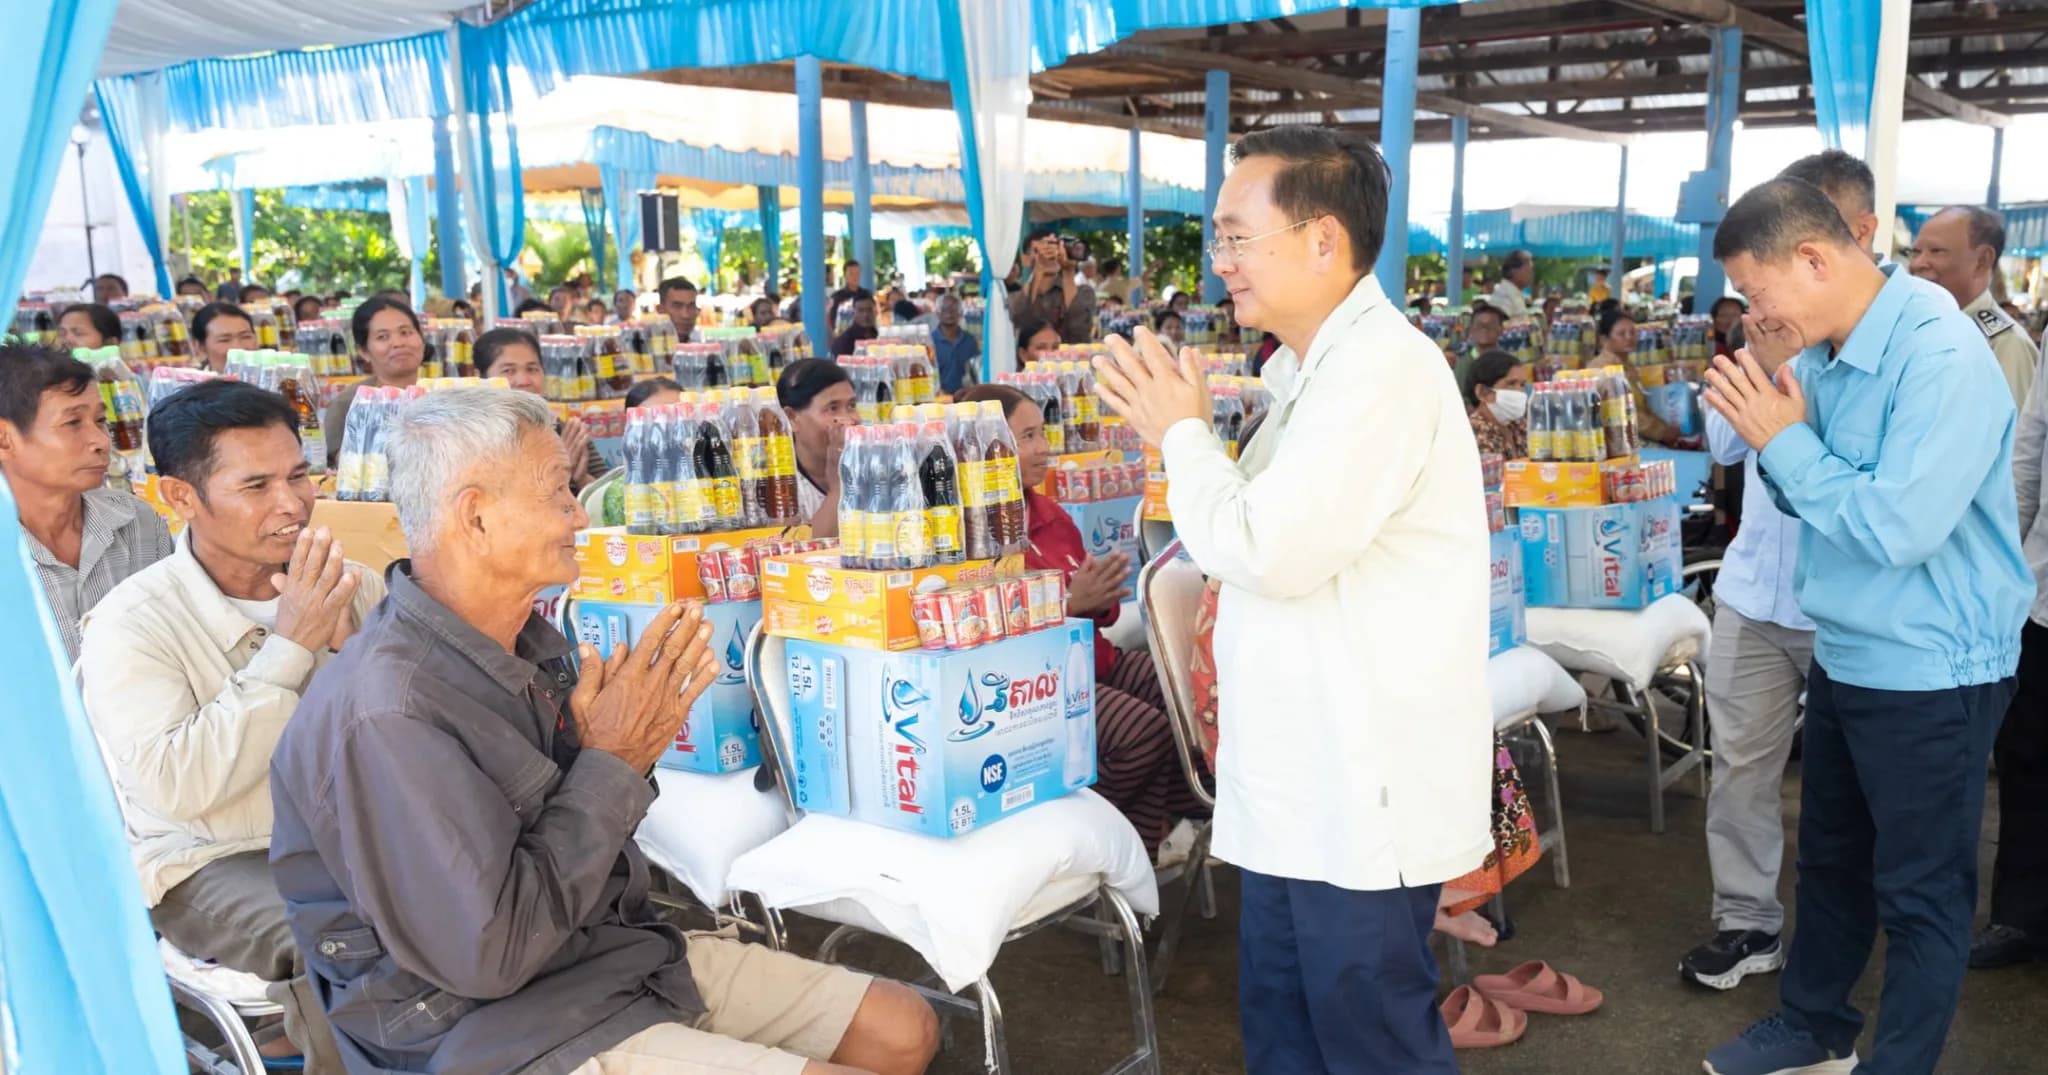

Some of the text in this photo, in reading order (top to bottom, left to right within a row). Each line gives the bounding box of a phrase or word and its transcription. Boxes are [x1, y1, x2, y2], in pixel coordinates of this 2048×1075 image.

[1602, 538, 1624, 598] Vital
[792, 655, 800, 669] 12
[792, 673, 801, 699] BTL
[802, 664, 813, 693] 1.5L
[724, 742, 743, 753] 1.5L
[720, 754, 747, 766] 12 BTL
[895, 713, 927, 814] Vital
[954, 804, 971, 817] 1.5L
[950, 816, 977, 831] 12 BTL
